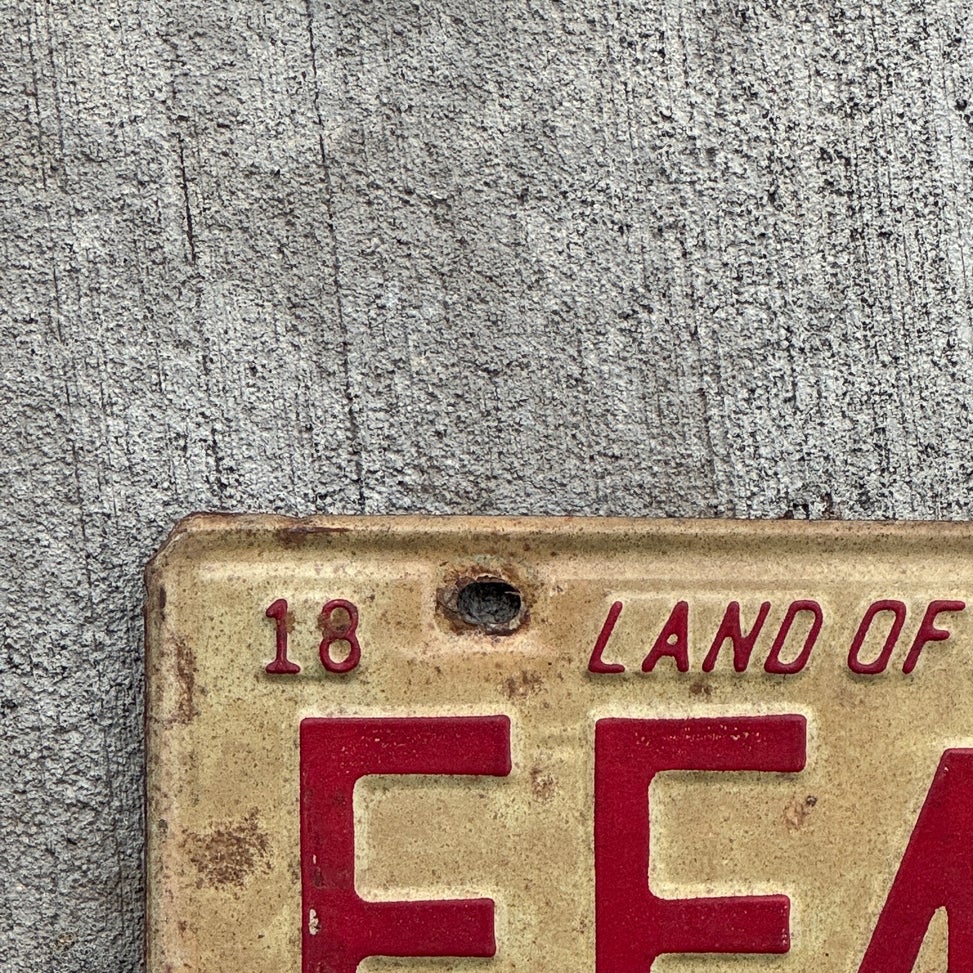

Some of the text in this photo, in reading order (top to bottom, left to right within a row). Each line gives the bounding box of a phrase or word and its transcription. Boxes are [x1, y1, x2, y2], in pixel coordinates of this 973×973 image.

[265, 597, 363, 676] 18
[588, 599, 825, 675] LAND
[846, 599, 967, 675] OF
